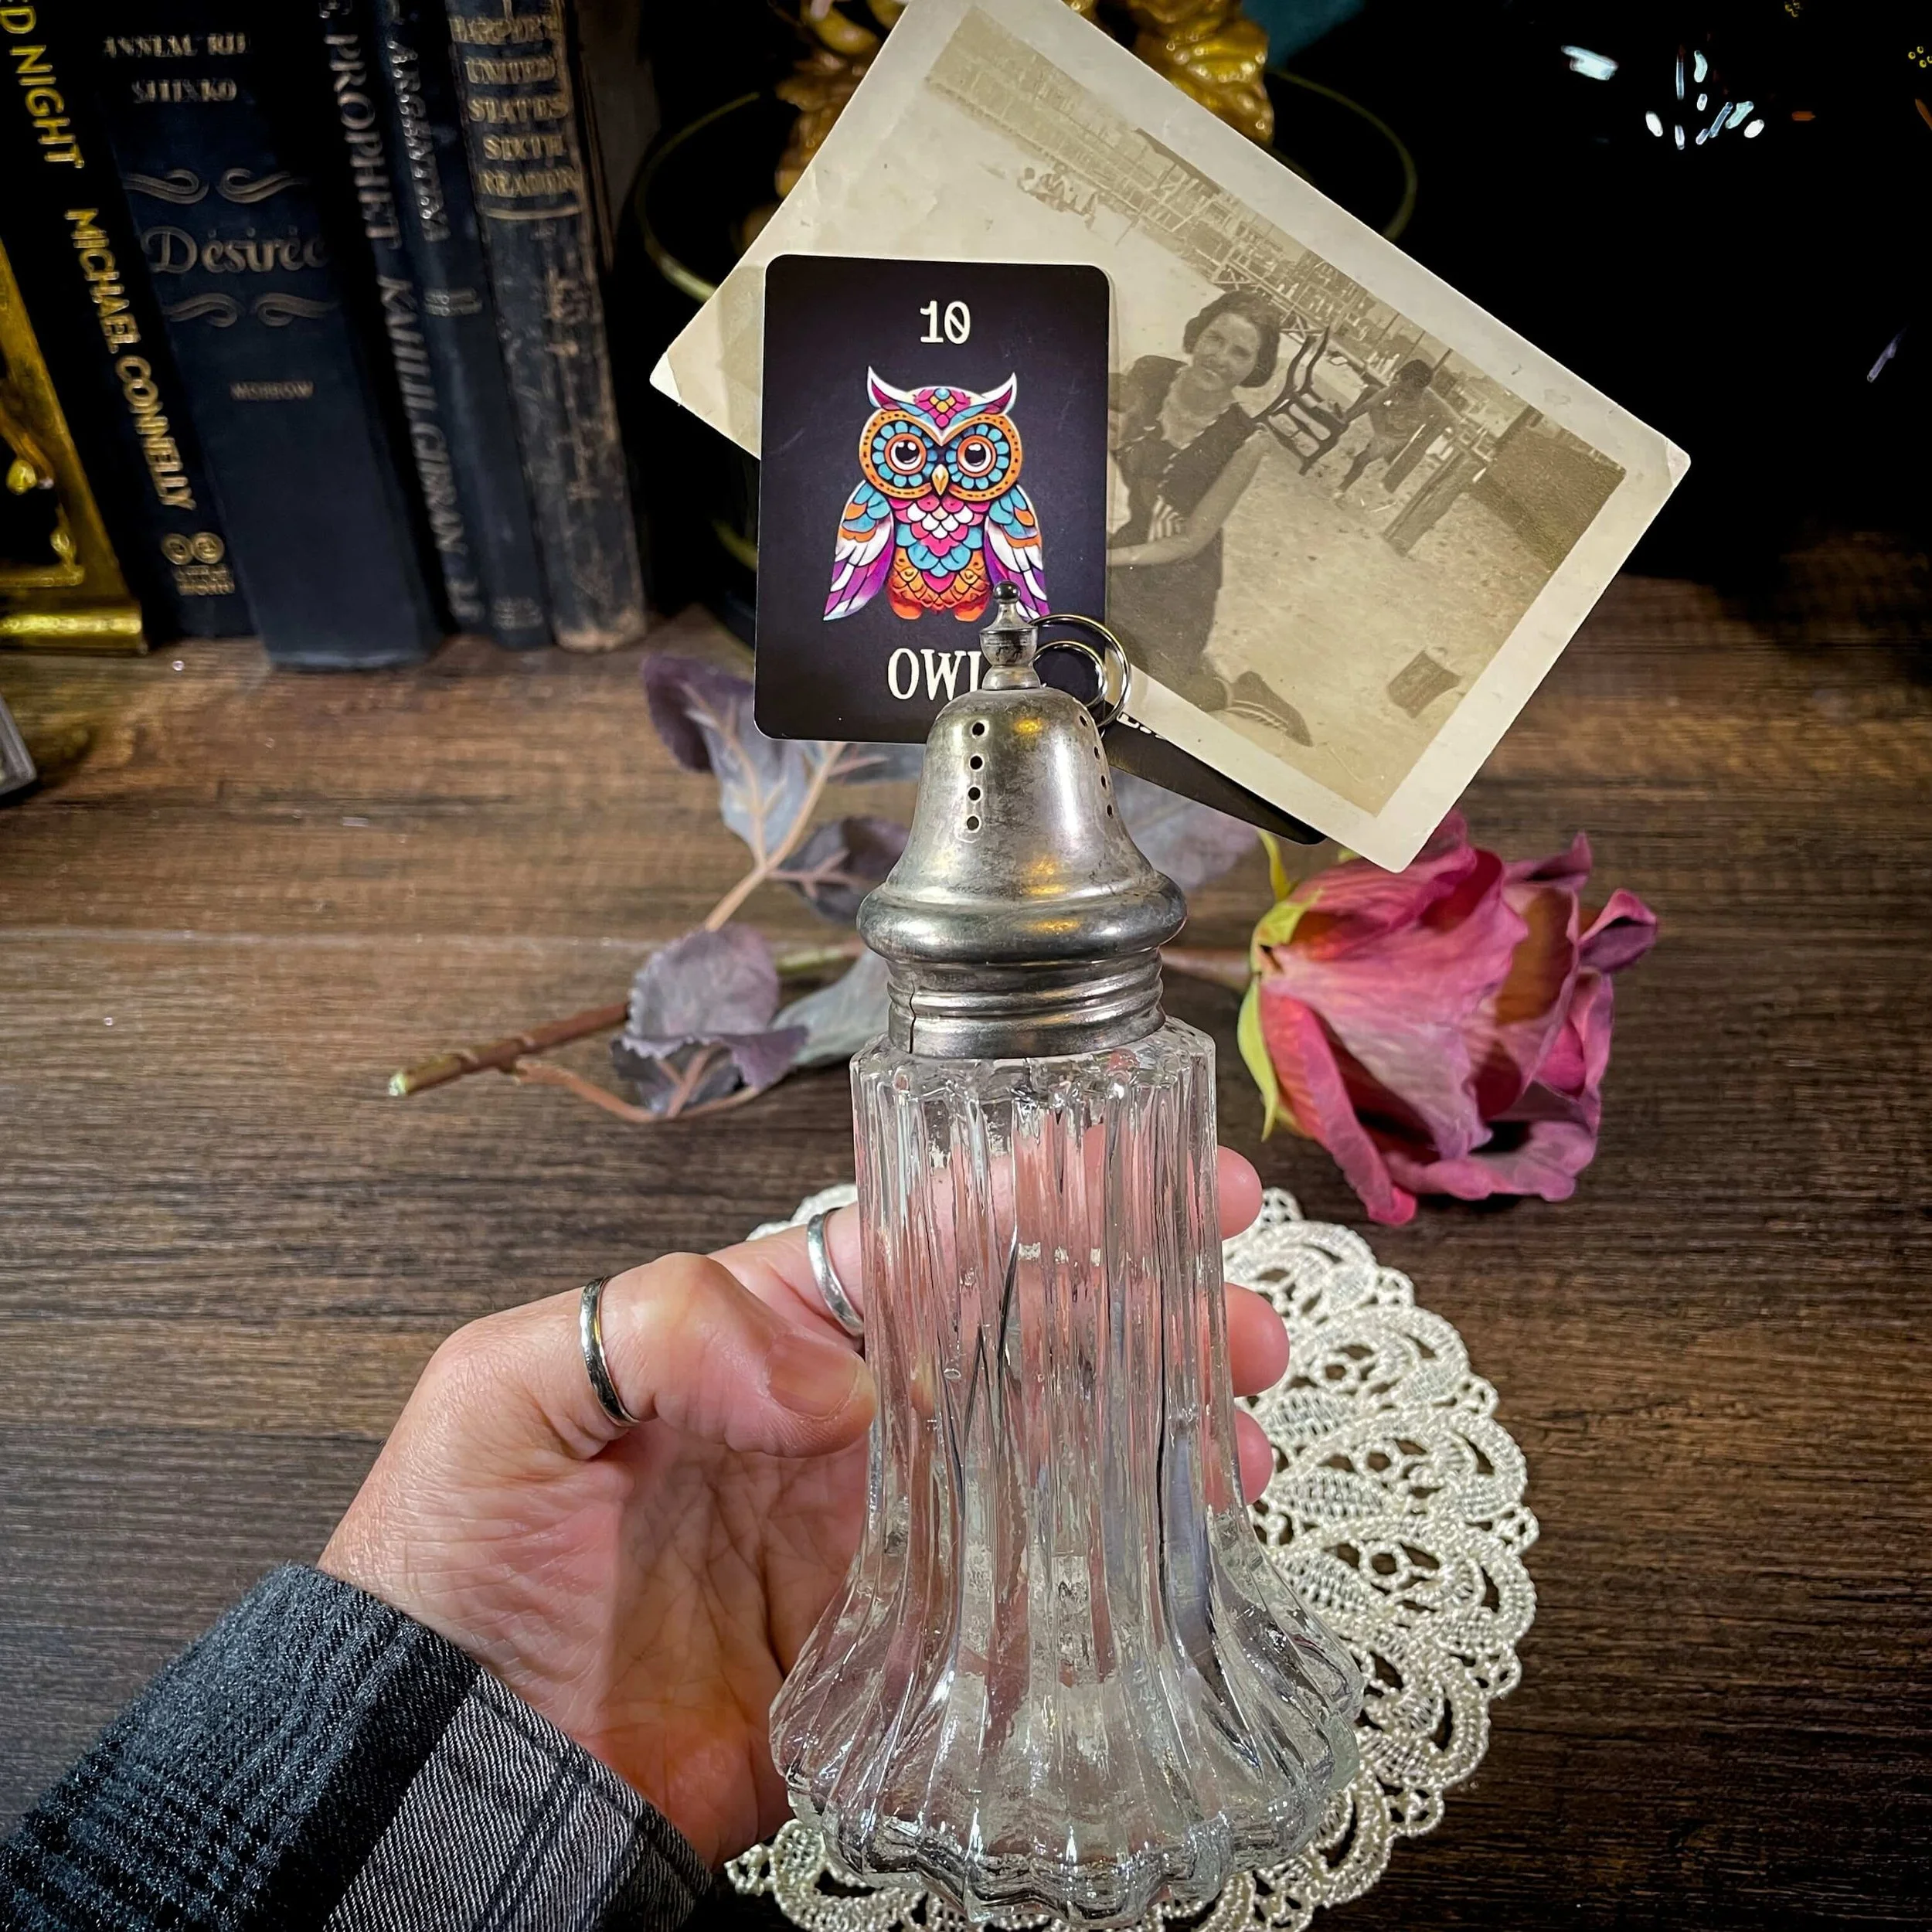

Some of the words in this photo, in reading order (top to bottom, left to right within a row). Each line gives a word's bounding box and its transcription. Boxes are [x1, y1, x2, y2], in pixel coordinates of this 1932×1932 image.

[464, 56, 558, 85] UNITED
[9, 44, 85, 168] NIGHT
[467, 94, 566, 124] STATES
[324, 34, 403, 250] PROPHET
[482, 133, 565, 162] SIXTH
[920, 300, 971, 345] 10
[64, 207, 141, 354] MICHAEL
[114, 355, 197, 511] CONNELLY
